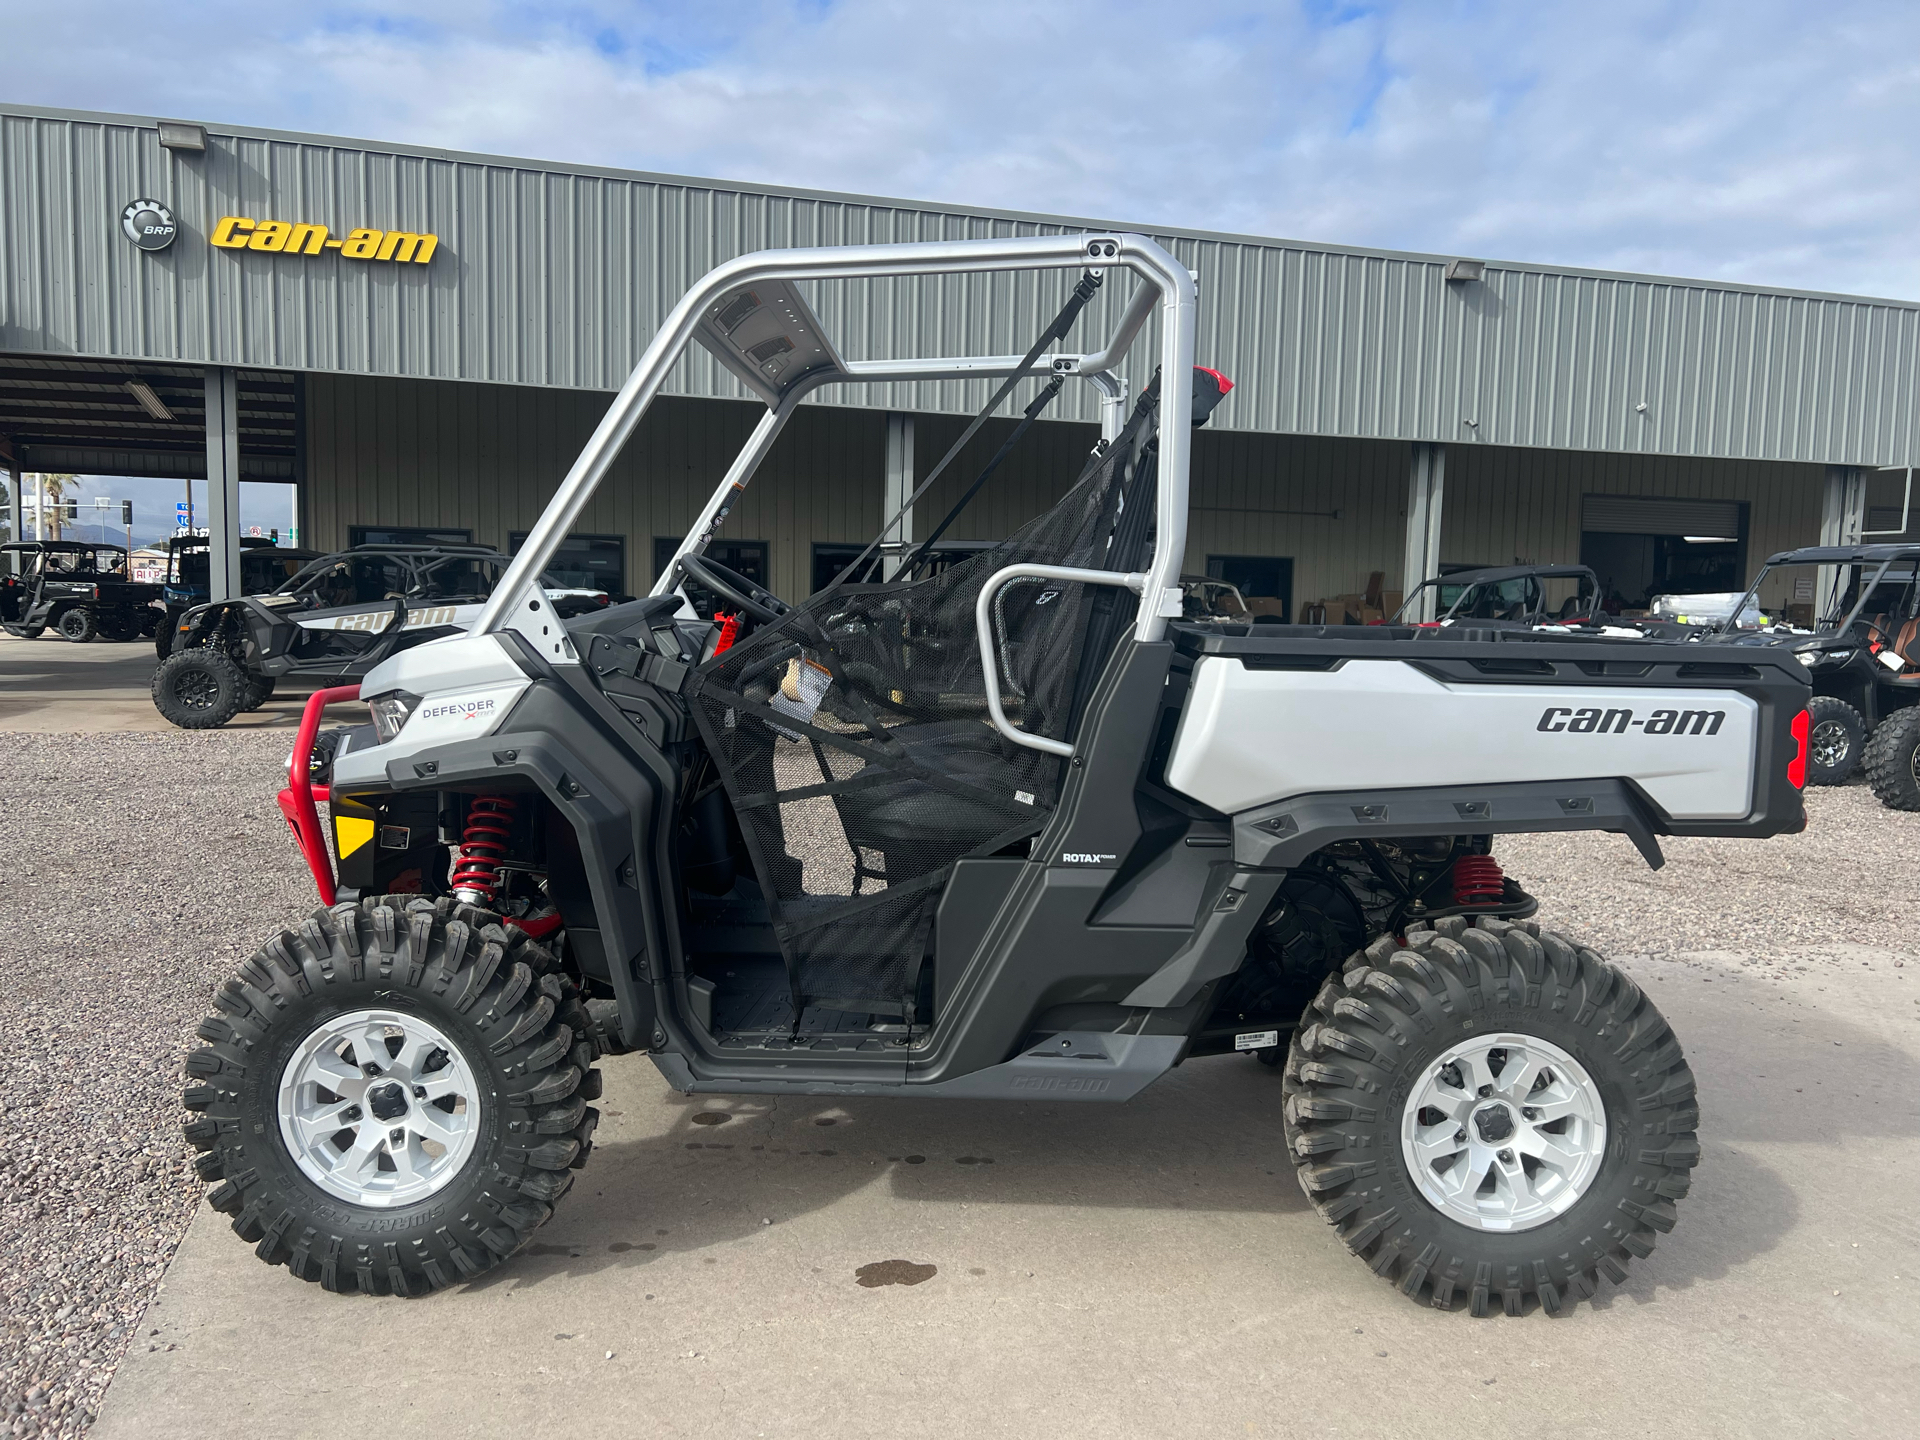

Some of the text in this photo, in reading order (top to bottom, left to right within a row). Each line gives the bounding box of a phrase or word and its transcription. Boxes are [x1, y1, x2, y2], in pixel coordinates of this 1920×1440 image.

[143, 225, 174, 235] BRP
[210, 215, 439, 264] can-am
[334, 606, 457, 631] canam
[423, 699, 495, 719] DEFENDER
[1536, 707, 1726, 736] can-am
[1062, 853, 1101, 863] ROTAX
